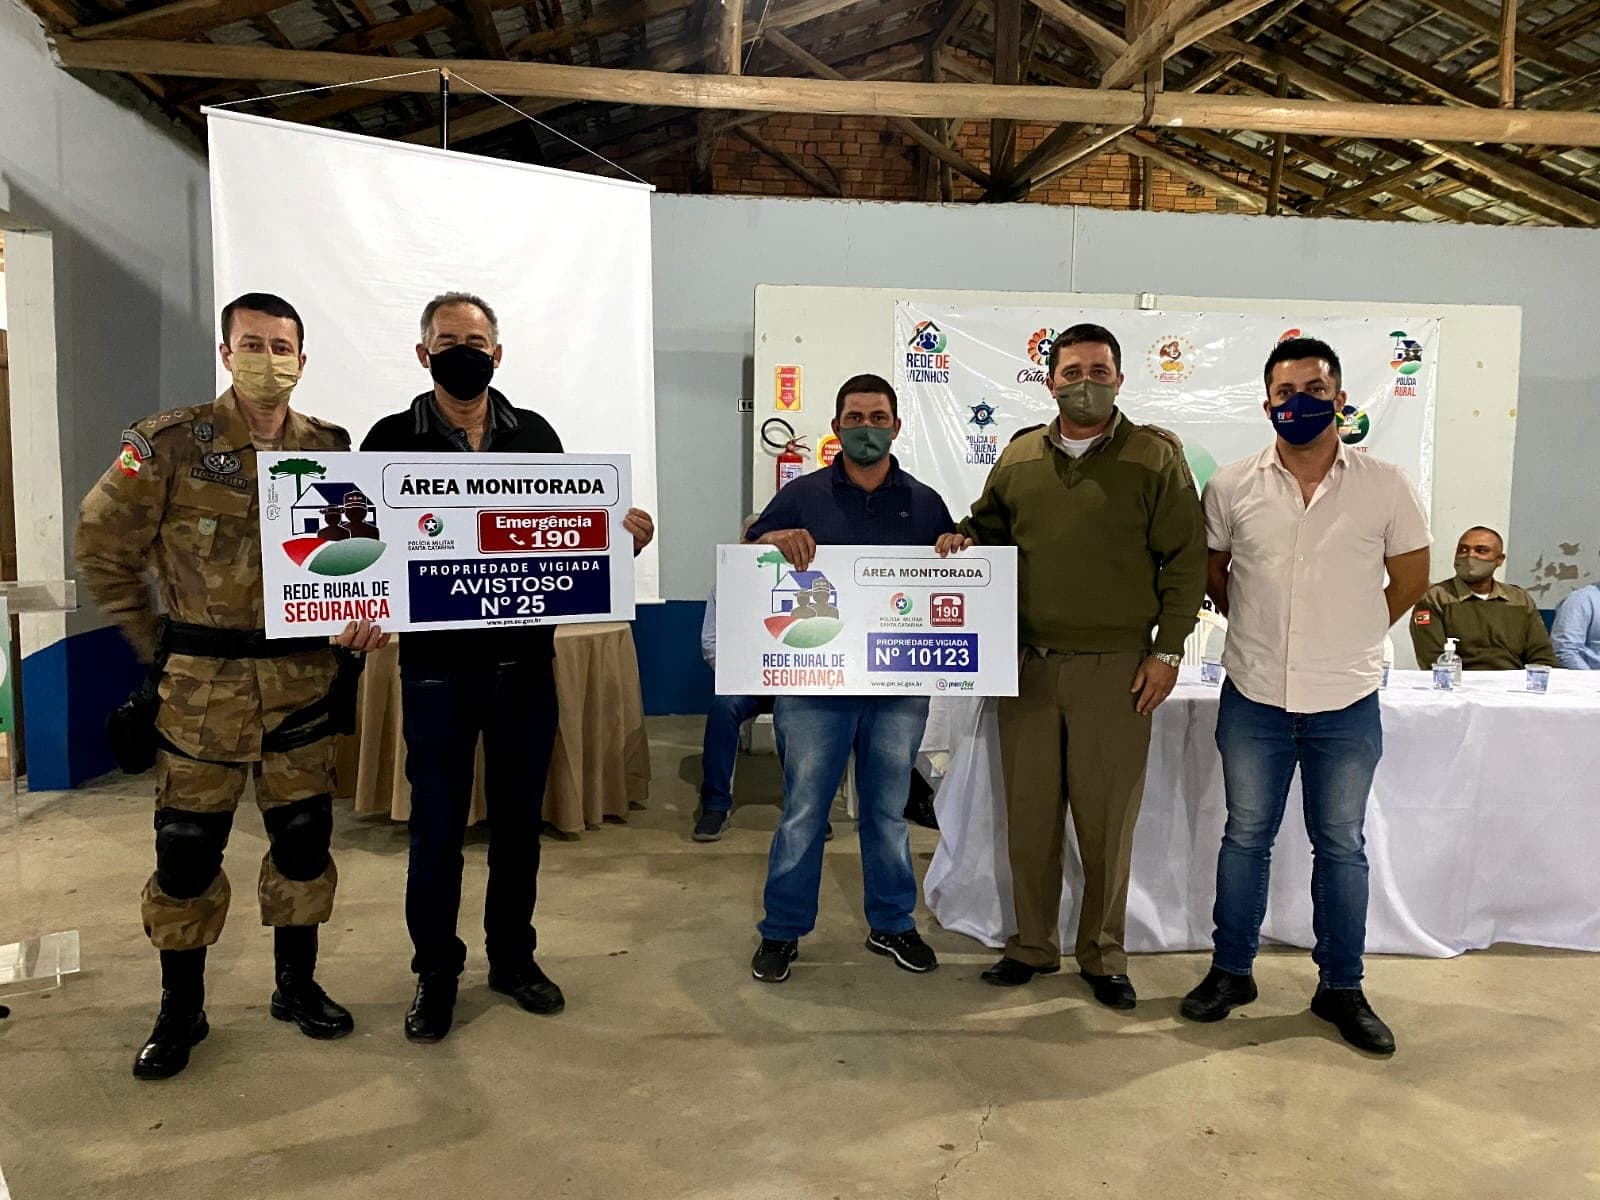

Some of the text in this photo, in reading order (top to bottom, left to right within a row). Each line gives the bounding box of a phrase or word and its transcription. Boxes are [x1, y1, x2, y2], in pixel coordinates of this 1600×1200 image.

[906, 353, 949, 368] REDE DE
[1396, 377, 1416, 385] POLÍCIA
[1394, 386, 1416, 396] RURAL
[966, 454, 996, 464] CIDADE
[400, 474, 605, 495] ÁREA MONITORADA
[496, 516, 591, 531] Emergência
[531, 531, 580, 548] 190
[419, 561, 600, 576] PROPRIEDADE VIGIADA
[863, 566, 983, 578] ÁREA MONITORADA
[283, 581, 390, 601] REDE RURAL DE
[450, 576, 573, 595] AVISTOSO
[285, 600, 390, 623] SEGURANÇA
[517, 596, 545, 615] 25
[936, 606, 959, 618] 190
[763, 654, 845, 667] REDE RURAL DE
[908, 649, 970, 666] 10123
[763, 669, 845, 689] SEGURANÇA
